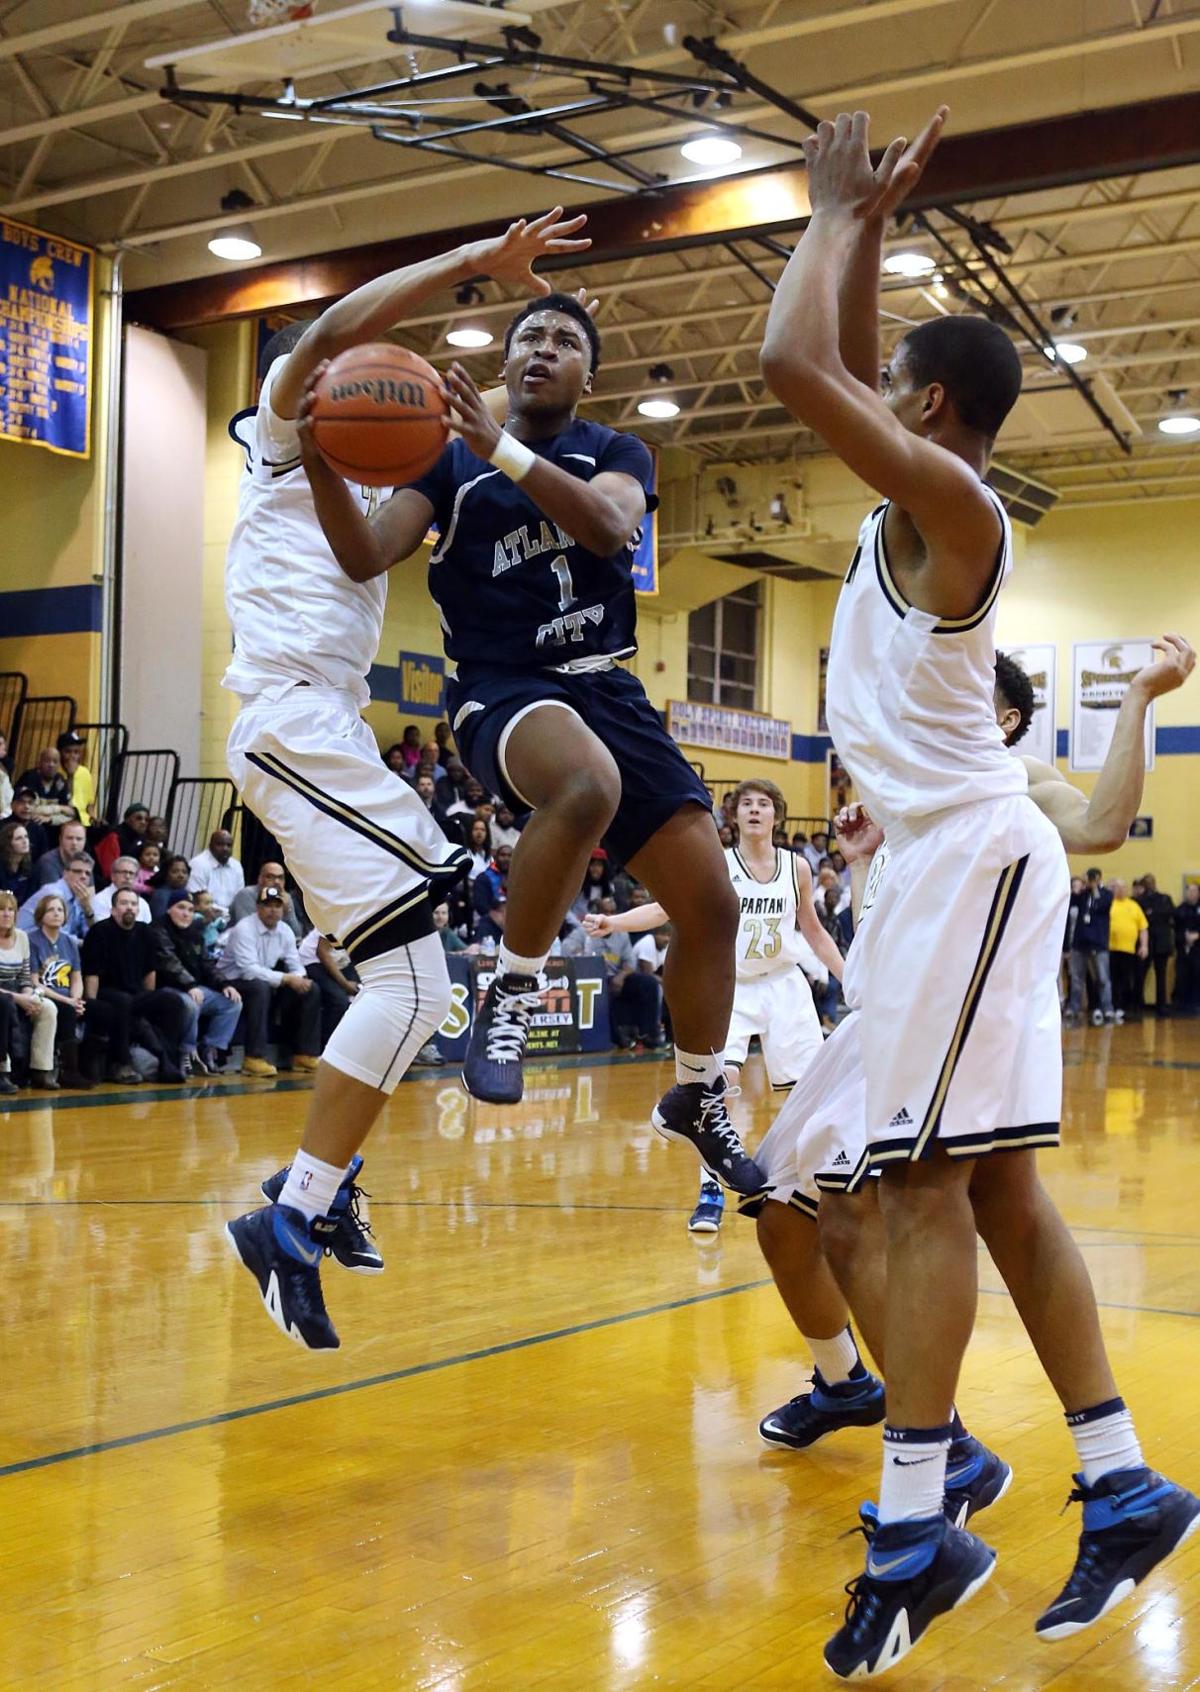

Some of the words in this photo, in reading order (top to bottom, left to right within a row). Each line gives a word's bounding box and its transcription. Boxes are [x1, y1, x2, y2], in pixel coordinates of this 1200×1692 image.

[3, 223, 39, 252] BOYS
[47, 240, 83, 267] CREW
[8, 284, 73, 320] NATIONAL
[331, 379, 425, 408] Wilson
[550, 554, 578, 612] 1
[402, 660, 443, 706] Visitor
[740, 897, 787, 914] PARTAN
[743, 918, 782, 960] 23
[533, 1015, 570, 1025] ERSEY
[576, 978, 602, 1030] T
